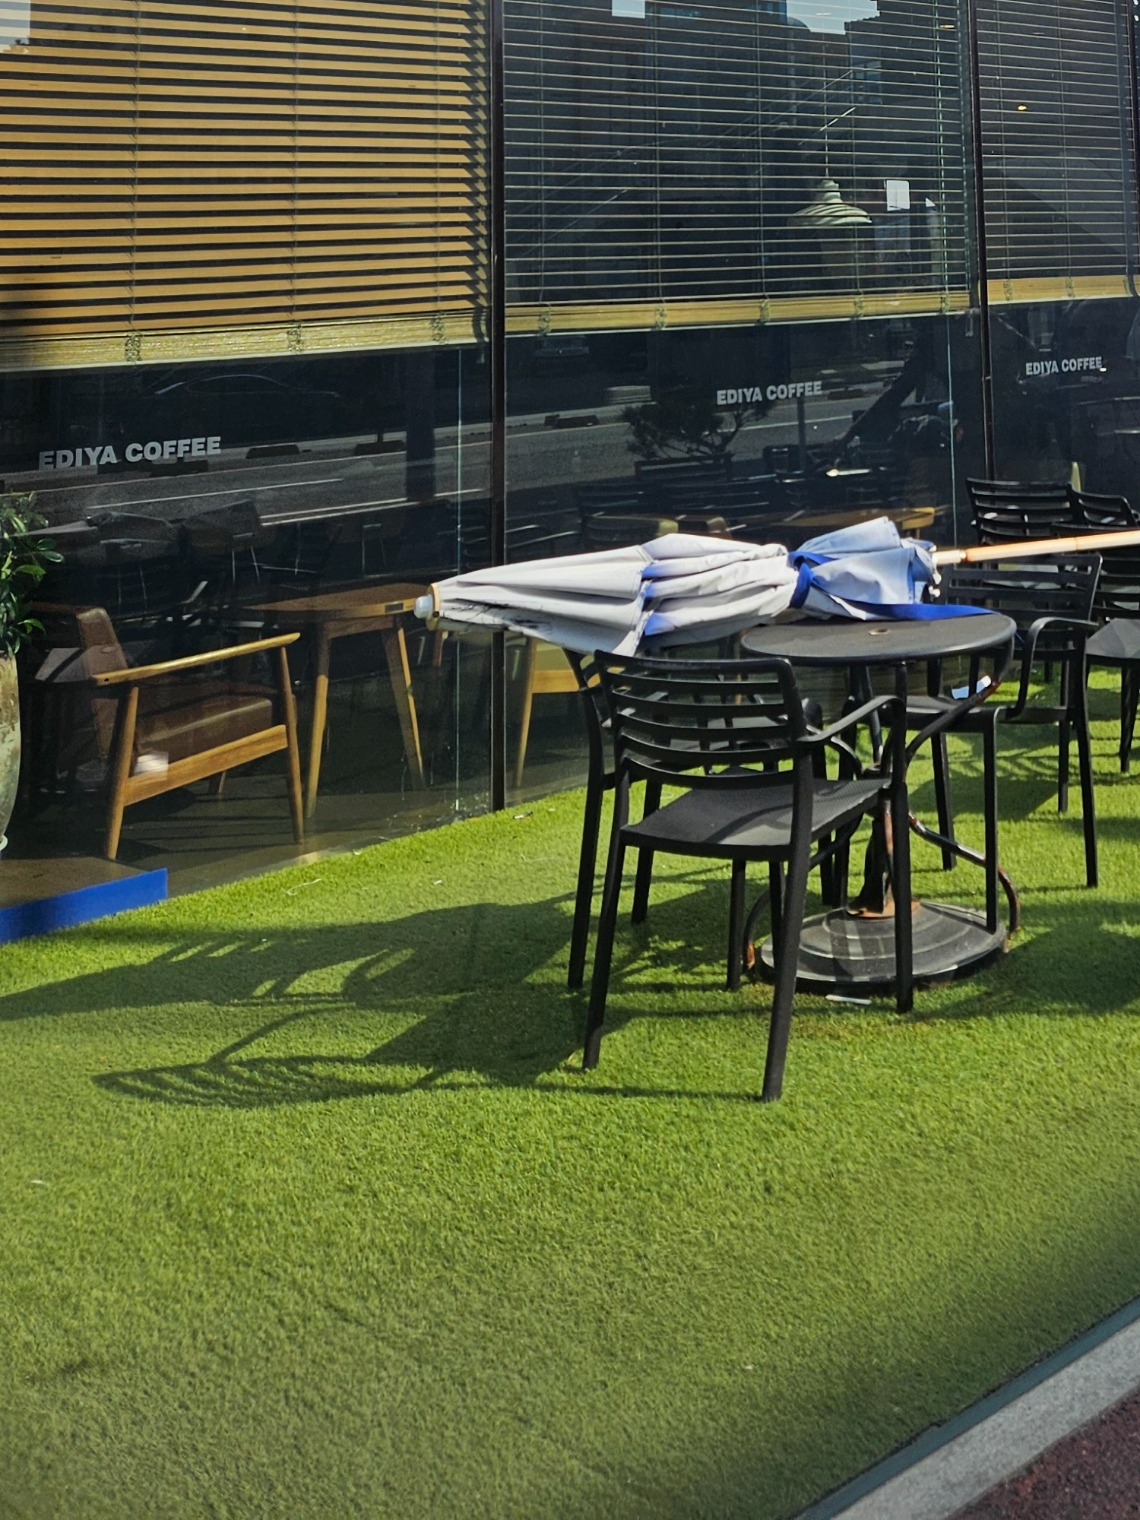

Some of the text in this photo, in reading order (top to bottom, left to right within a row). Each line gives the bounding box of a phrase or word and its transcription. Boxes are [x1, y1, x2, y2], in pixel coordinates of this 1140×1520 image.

[1025, 356, 1102, 376] EDIYA COFFEE
[716, 381, 823, 406] EDIYA COFFEE
[38, 436, 222, 471] EDIYA COFFEE
